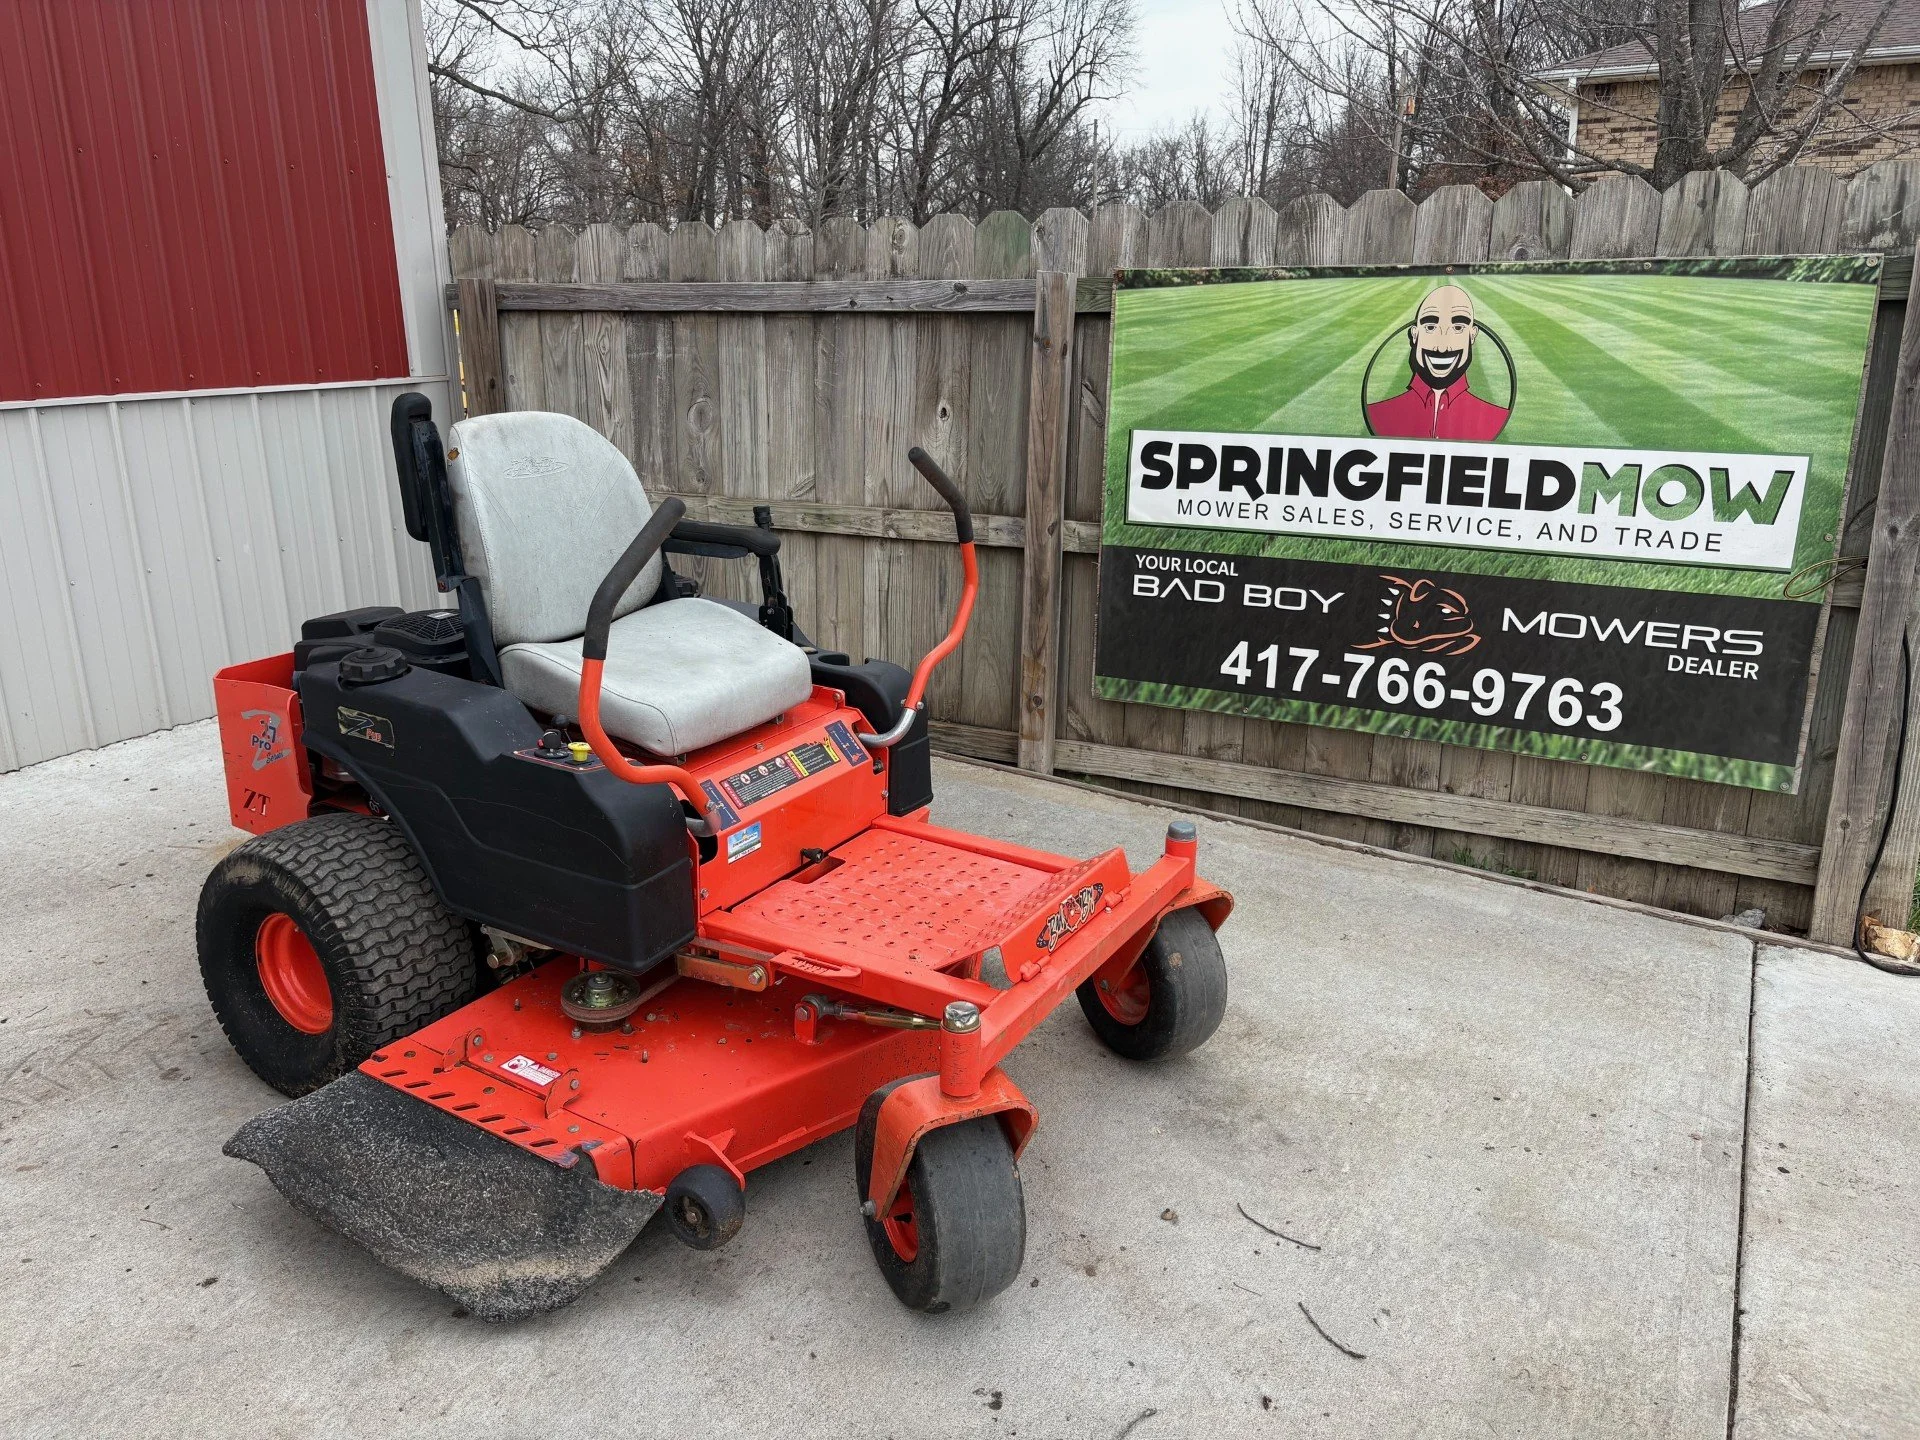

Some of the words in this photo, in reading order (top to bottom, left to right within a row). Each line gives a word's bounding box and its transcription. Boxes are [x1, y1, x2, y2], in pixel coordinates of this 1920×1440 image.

[1177, 498, 1269, 521] MOWER
[1282, 504, 1375, 531] SALES,
[1388, 511, 1523, 542] SERVICE,
[1537, 521, 1598, 544] AND
[1615, 526, 1723, 553] TRADE
[1135, 554, 1181, 572] YOUR
[1185, 558, 1239, 578] LOCAL
[1132, 574, 1225, 603] BAD
[1243, 583, 1345, 614] BOY
[1501, 607, 1764, 656] MOWERS
[1667, 654, 1760, 681] DEALER
[1219, 640, 1624, 732] 417-766-9763
[251, 733, 272, 751] Pro
[243, 787, 272, 817] ZT
